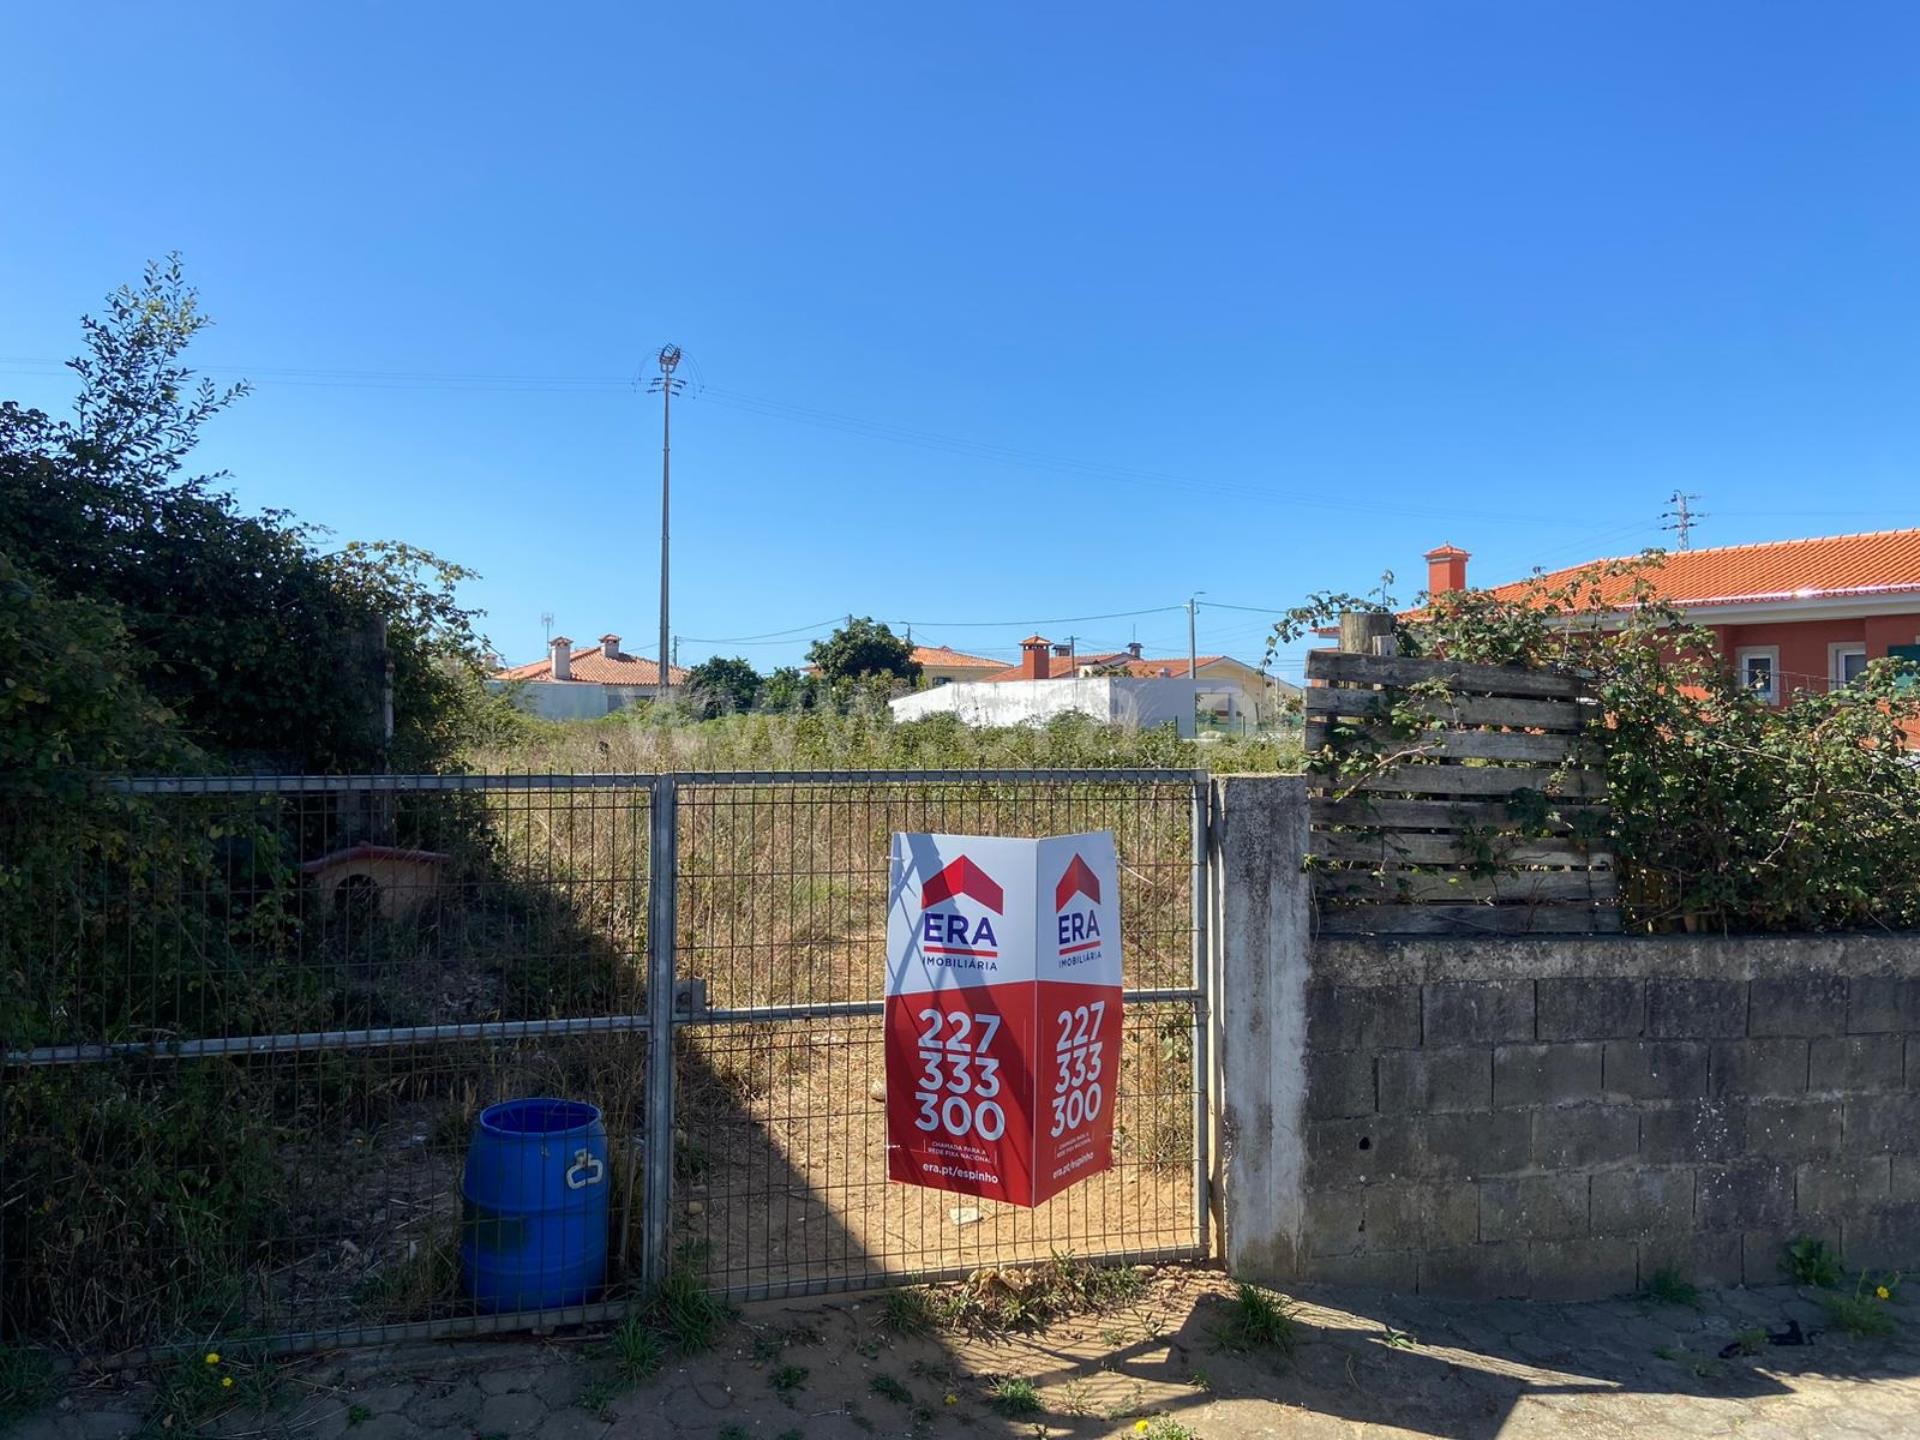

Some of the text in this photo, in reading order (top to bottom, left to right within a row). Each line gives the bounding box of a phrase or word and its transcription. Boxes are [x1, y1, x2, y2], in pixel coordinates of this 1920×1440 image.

[924, 912, 998, 947] ERA
[1058, 909, 1101, 946] ERA
[923, 956, 998, 972] IMOBILIÁRIA
[1058, 951, 1102, 969] IMOBILIÁRIA
[918, 1008, 1001, 1054] 227
[1056, 1000, 1105, 1052] 227
[918, 1050, 1000, 1098] 333
[1055, 1041, 1103, 1094] 333
[914, 1091, 1005, 1142] 300
[1050, 1082, 1101, 1138] 300
[963, 1145, 981, 1154] PARA
[922, 1163, 999, 1184] era.pt/espinho
